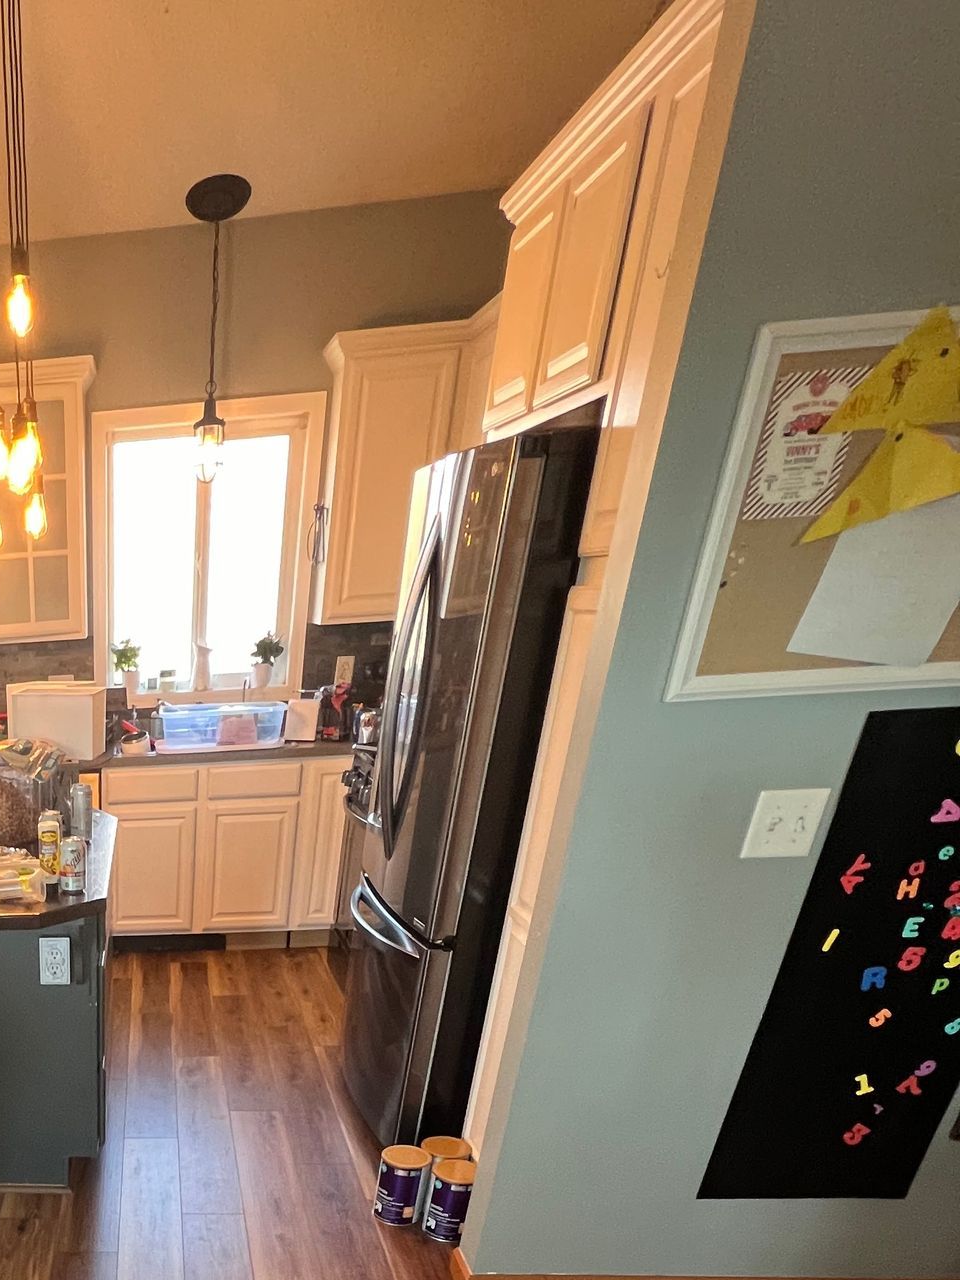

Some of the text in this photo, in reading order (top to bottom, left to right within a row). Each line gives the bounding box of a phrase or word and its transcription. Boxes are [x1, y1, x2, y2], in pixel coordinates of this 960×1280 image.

[896, 877, 920, 900] H
[902, 916, 925, 938] E
[854, 1073, 875, 1096] 1
